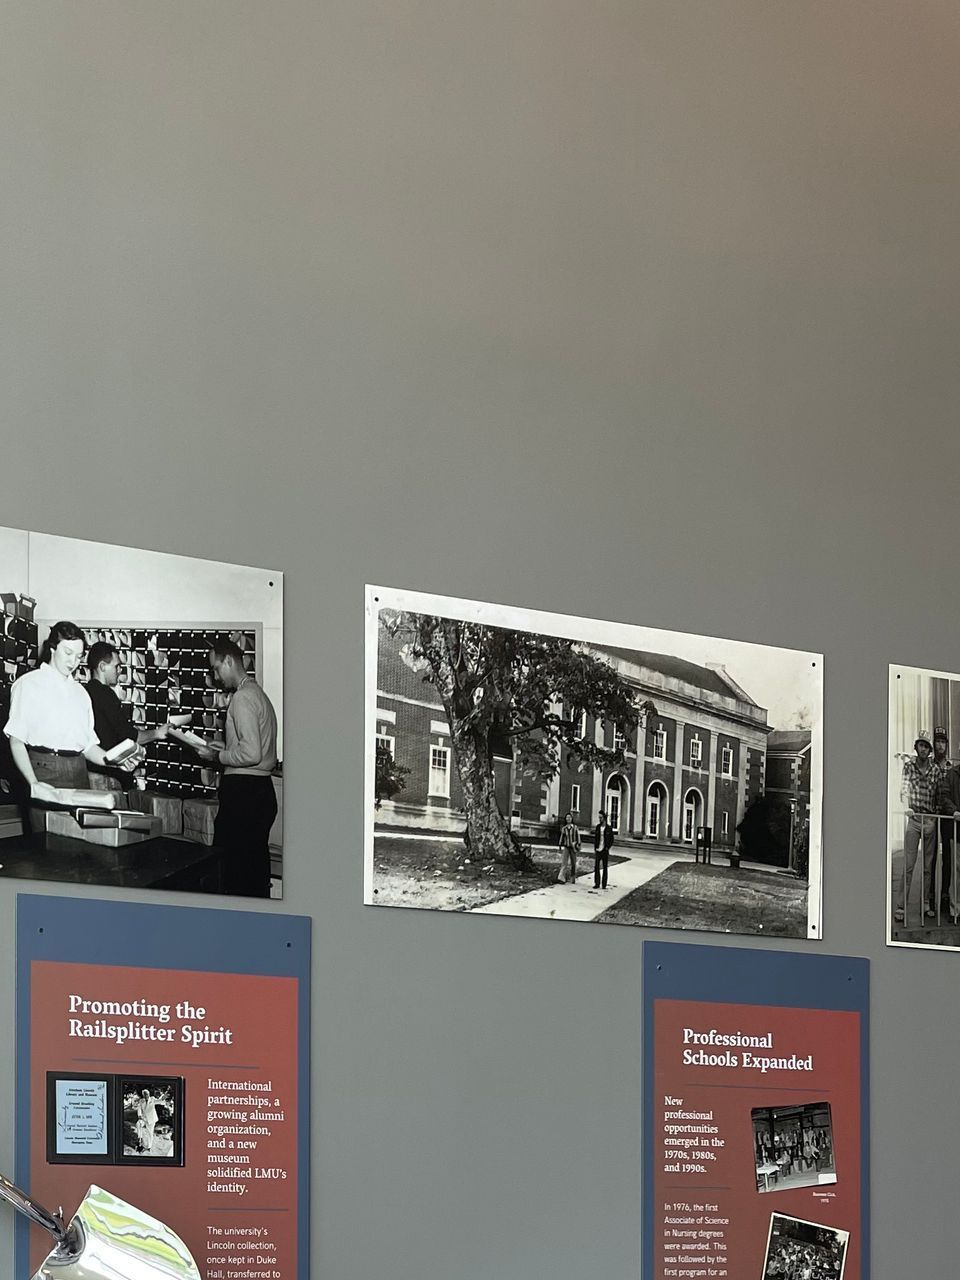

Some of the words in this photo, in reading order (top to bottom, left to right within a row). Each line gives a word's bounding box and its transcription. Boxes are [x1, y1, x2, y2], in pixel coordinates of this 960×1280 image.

[69, 995, 171, 1023] Promoting
[175, 1001, 206, 1020] the
[69, 1019, 176, 1044] Railsplitter
[181, 1025, 233, 1048] Spirit
[683, 1029, 772, 1048] Professional
[683, 1049, 738, 1067] Schools
[742, 1052, 813, 1072] Expanded
[208, 1079, 272, 1092] International
[208, 1095, 272, 1108] partnerships,
[665, 1096, 683, 1106] New
[207, 1109, 248, 1123] growing
[250, 1110, 284, 1121] alumni
[664, 1110, 713, 1121] professional
[207, 1124, 271, 1136] organization,
[664, 1124, 718, 1135] opportunities
[207, 1138, 226, 1148] and
[664, 1137, 699, 1149] emerged
[701, 1137, 710, 1146] in
[711, 1137, 725, 1147] the
[208, 1155, 250, 1163] museum
[665, 1150, 690, 1160] 1970s,
[692, 1151, 717, 1161] 1980s,
[207, 1167, 252, 1178] solidified
[255, 1168, 287, 1179] LMU's
[664, 1162, 680, 1172] and
[682, 1164, 707, 1173] 1990s.
[207, 1182, 248, 1196] identity.
[673, 1203, 692, 1212] 1976,
[664, 1216, 695, 1224] Associate
[704, 1216, 729, 1224] Science
[207, 1226, 223, 1235] The
[224, 1227, 268, 1237] university's
[672, 1229, 697, 1239] Nursing
[698, 1230, 724, 1239] degrees
[207, 1241, 235, 1250] Lincoln
[237, 1241, 277, 1251] collection,
[228, 1256, 245, 1266] kept
[257, 1255, 277, 1264] Duke
[207, 1270, 225, 1279] Hall,
[227, 1270, 271, 1278] transferred
[272, 1270, 281, 1278] to
